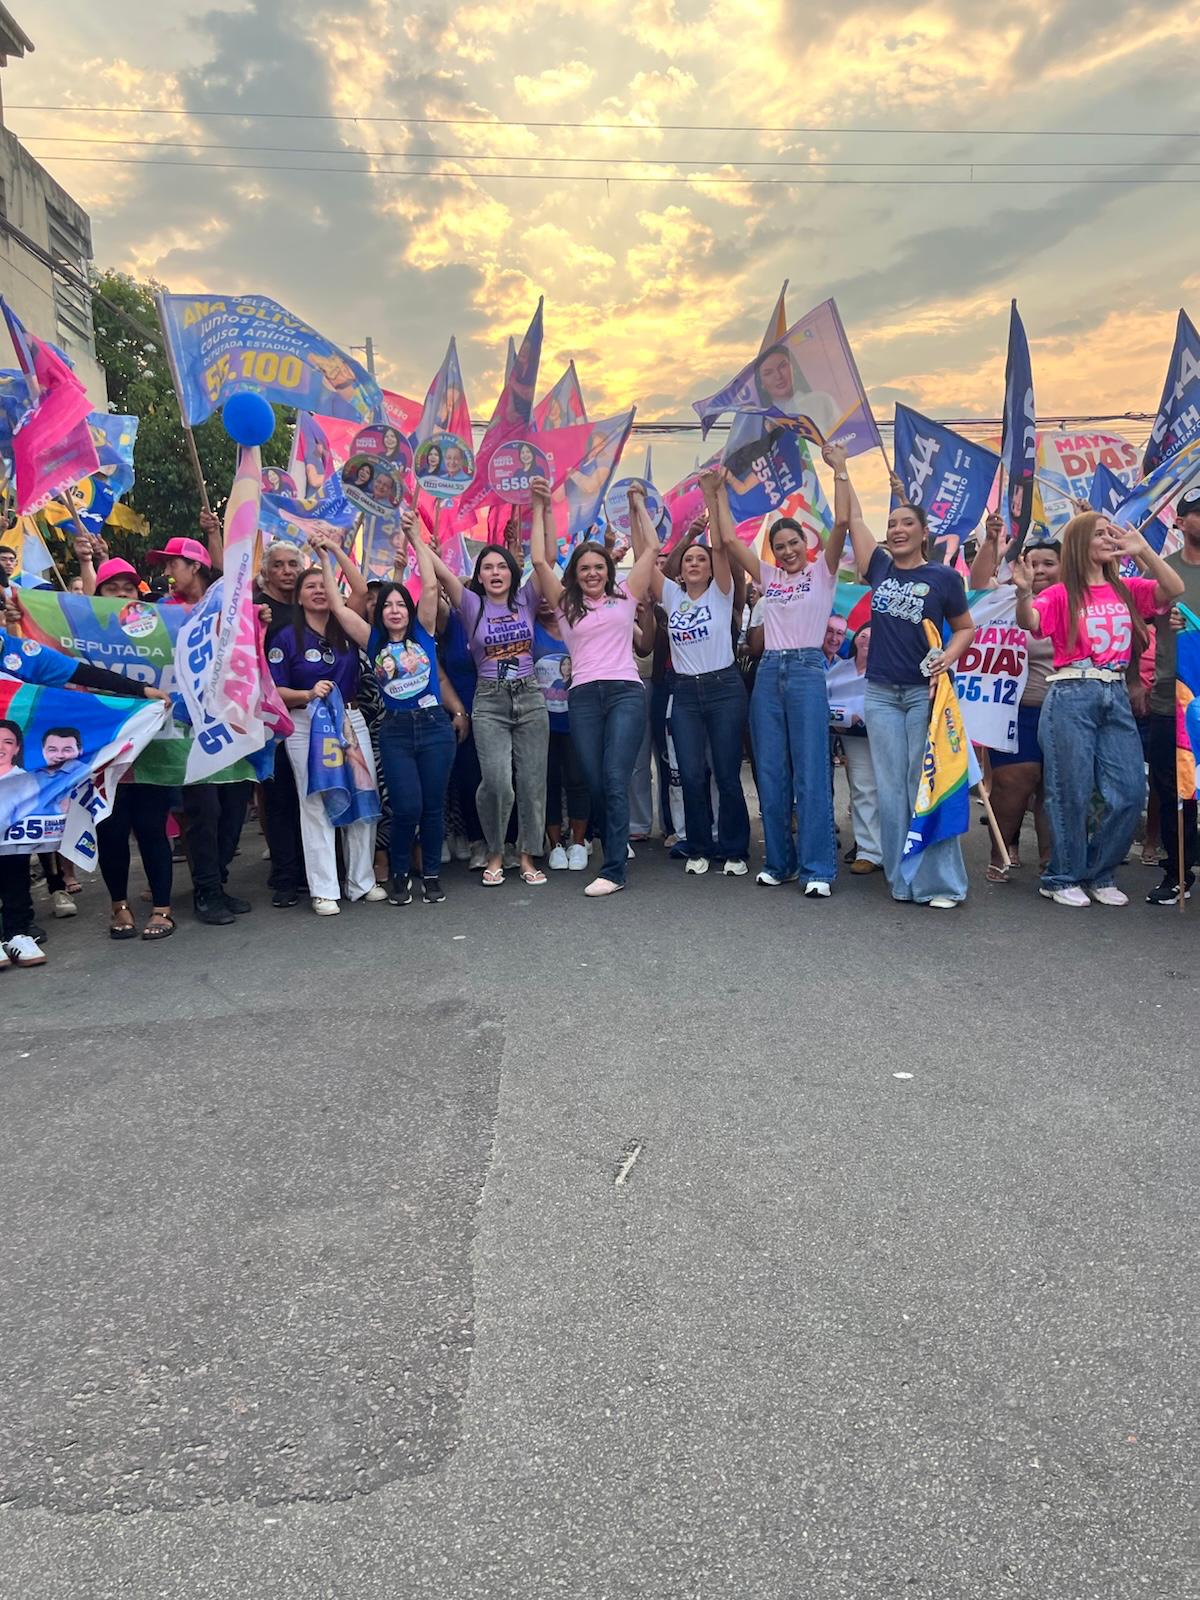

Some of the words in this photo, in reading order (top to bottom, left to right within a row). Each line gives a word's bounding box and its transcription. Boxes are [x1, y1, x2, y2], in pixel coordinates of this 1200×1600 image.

[184, 301, 227, 330] ANA
[252, 319, 297, 336] pela
[243, 328, 310, 349] Animal
[246, 340, 304, 358] ESTADUAL
[1060, 443, 1138, 478] DIAS
[751, 455, 781, 506] 5544
[926, 471, 962, 534] NATH
[937, 477, 969, 536] NASCIMENTO
[60, 636, 165, 658] DEPUTADA
[484, 628, 532, 646] OLIVEIRA
[671, 625, 709, 642] NATH
[1086, 614, 1132, 654] 55
[956, 647, 1027, 677] DIAS
